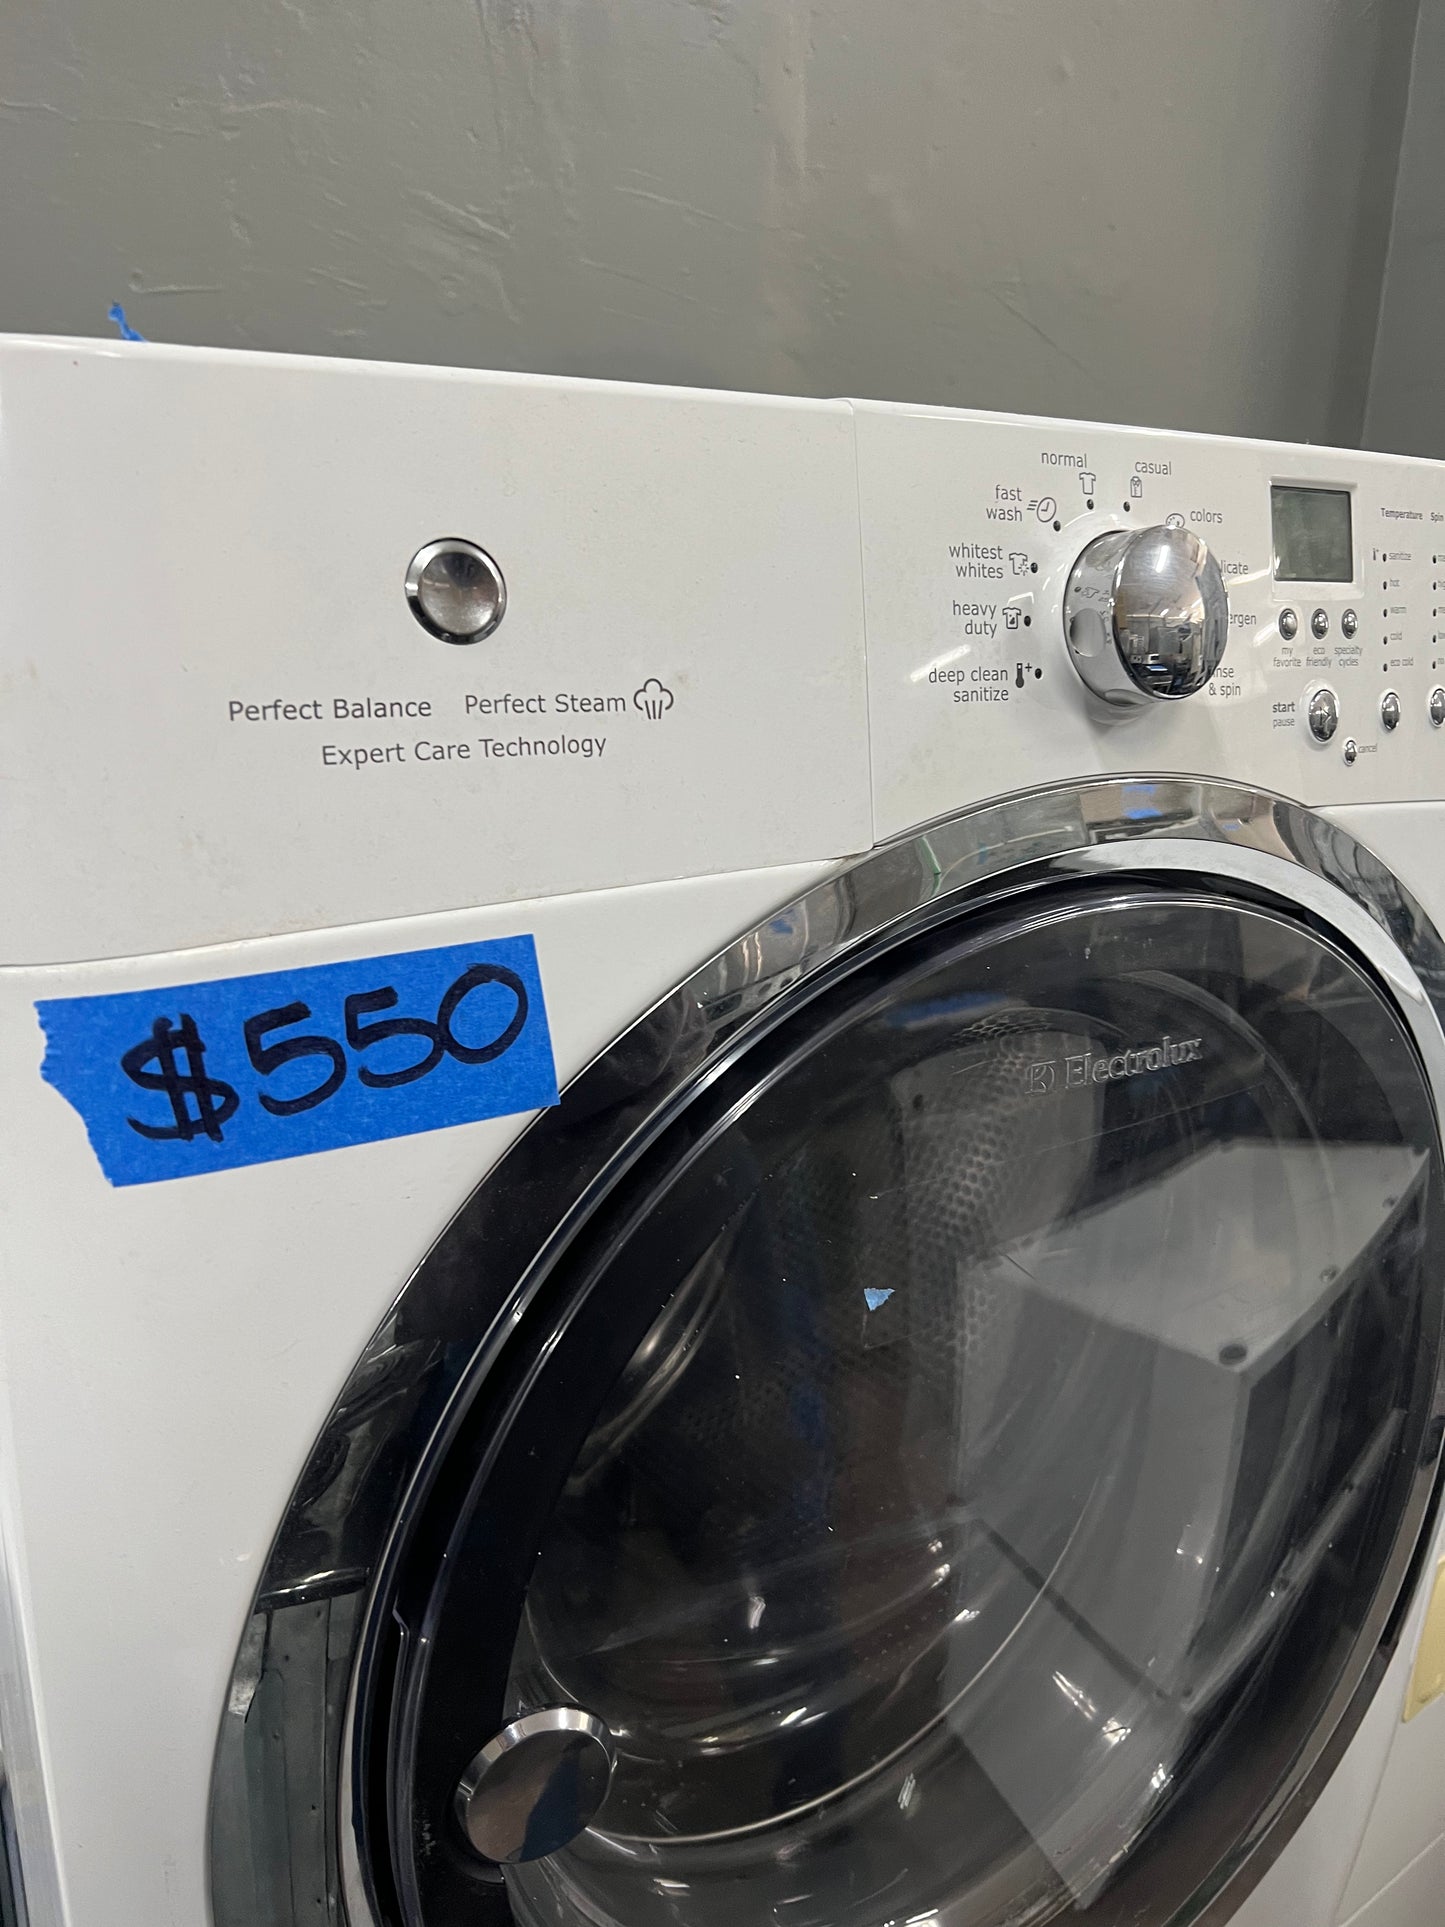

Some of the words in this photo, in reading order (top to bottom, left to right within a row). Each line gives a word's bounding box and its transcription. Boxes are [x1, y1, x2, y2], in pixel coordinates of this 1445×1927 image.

[1041, 451, 1087, 468] normal
[1135, 460, 1172, 475] casual
[995, 484, 1023, 501] fast
[986, 505, 1023, 522] wash
[1190, 509, 1223, 524] colors
[1380, 507, 1423, 520] Temperature
[1430, 511, 1445, 523] Spin
[949, 543, 1003, 560] whitest
[956, 562, 1004, 579] whites
[1220, 560, 1249, 575] licate
[953, 600, 997, 620] heavy
[1230, 613, 1257, 628] ergen
[965, 620, 998, 638] duty
[1281, 647, 1293, 657] my
[1312, 647, 1325, 655] eco
[1334, 645, 1363, 657] specialty
[1273, 656, 1301, 667] favorite
[1306, 656, 1332, 668] friendly
[1338, 656, 1359, 668] cycles
[929, 667, 965, 684] deep
[971, 665, 1008, 681] clean
[953, 686, 1009, 703] sanitize
[1208, 682, 1217, 696] &
[1220, 683, 1241, 698] spin
[229, 698, 322, 721] Perfect
[334, 696, 432, 719] Balance
[465, 692, 546, 714] Perfect
[555, 692, 626, 713] Steam
[1272, 702, 1296, 713] start
[1272, 717, 1296, 729] pause
[322, 744, 406, 770] Expert
[415, 740, 471, 762] Care
[479, 734, 607, 758] Technology
[1359, 744, 1377, 754] cancel
[120, 962, 529, 1143] $550
[1064, 1035, 1204, 1090] Electrolux
